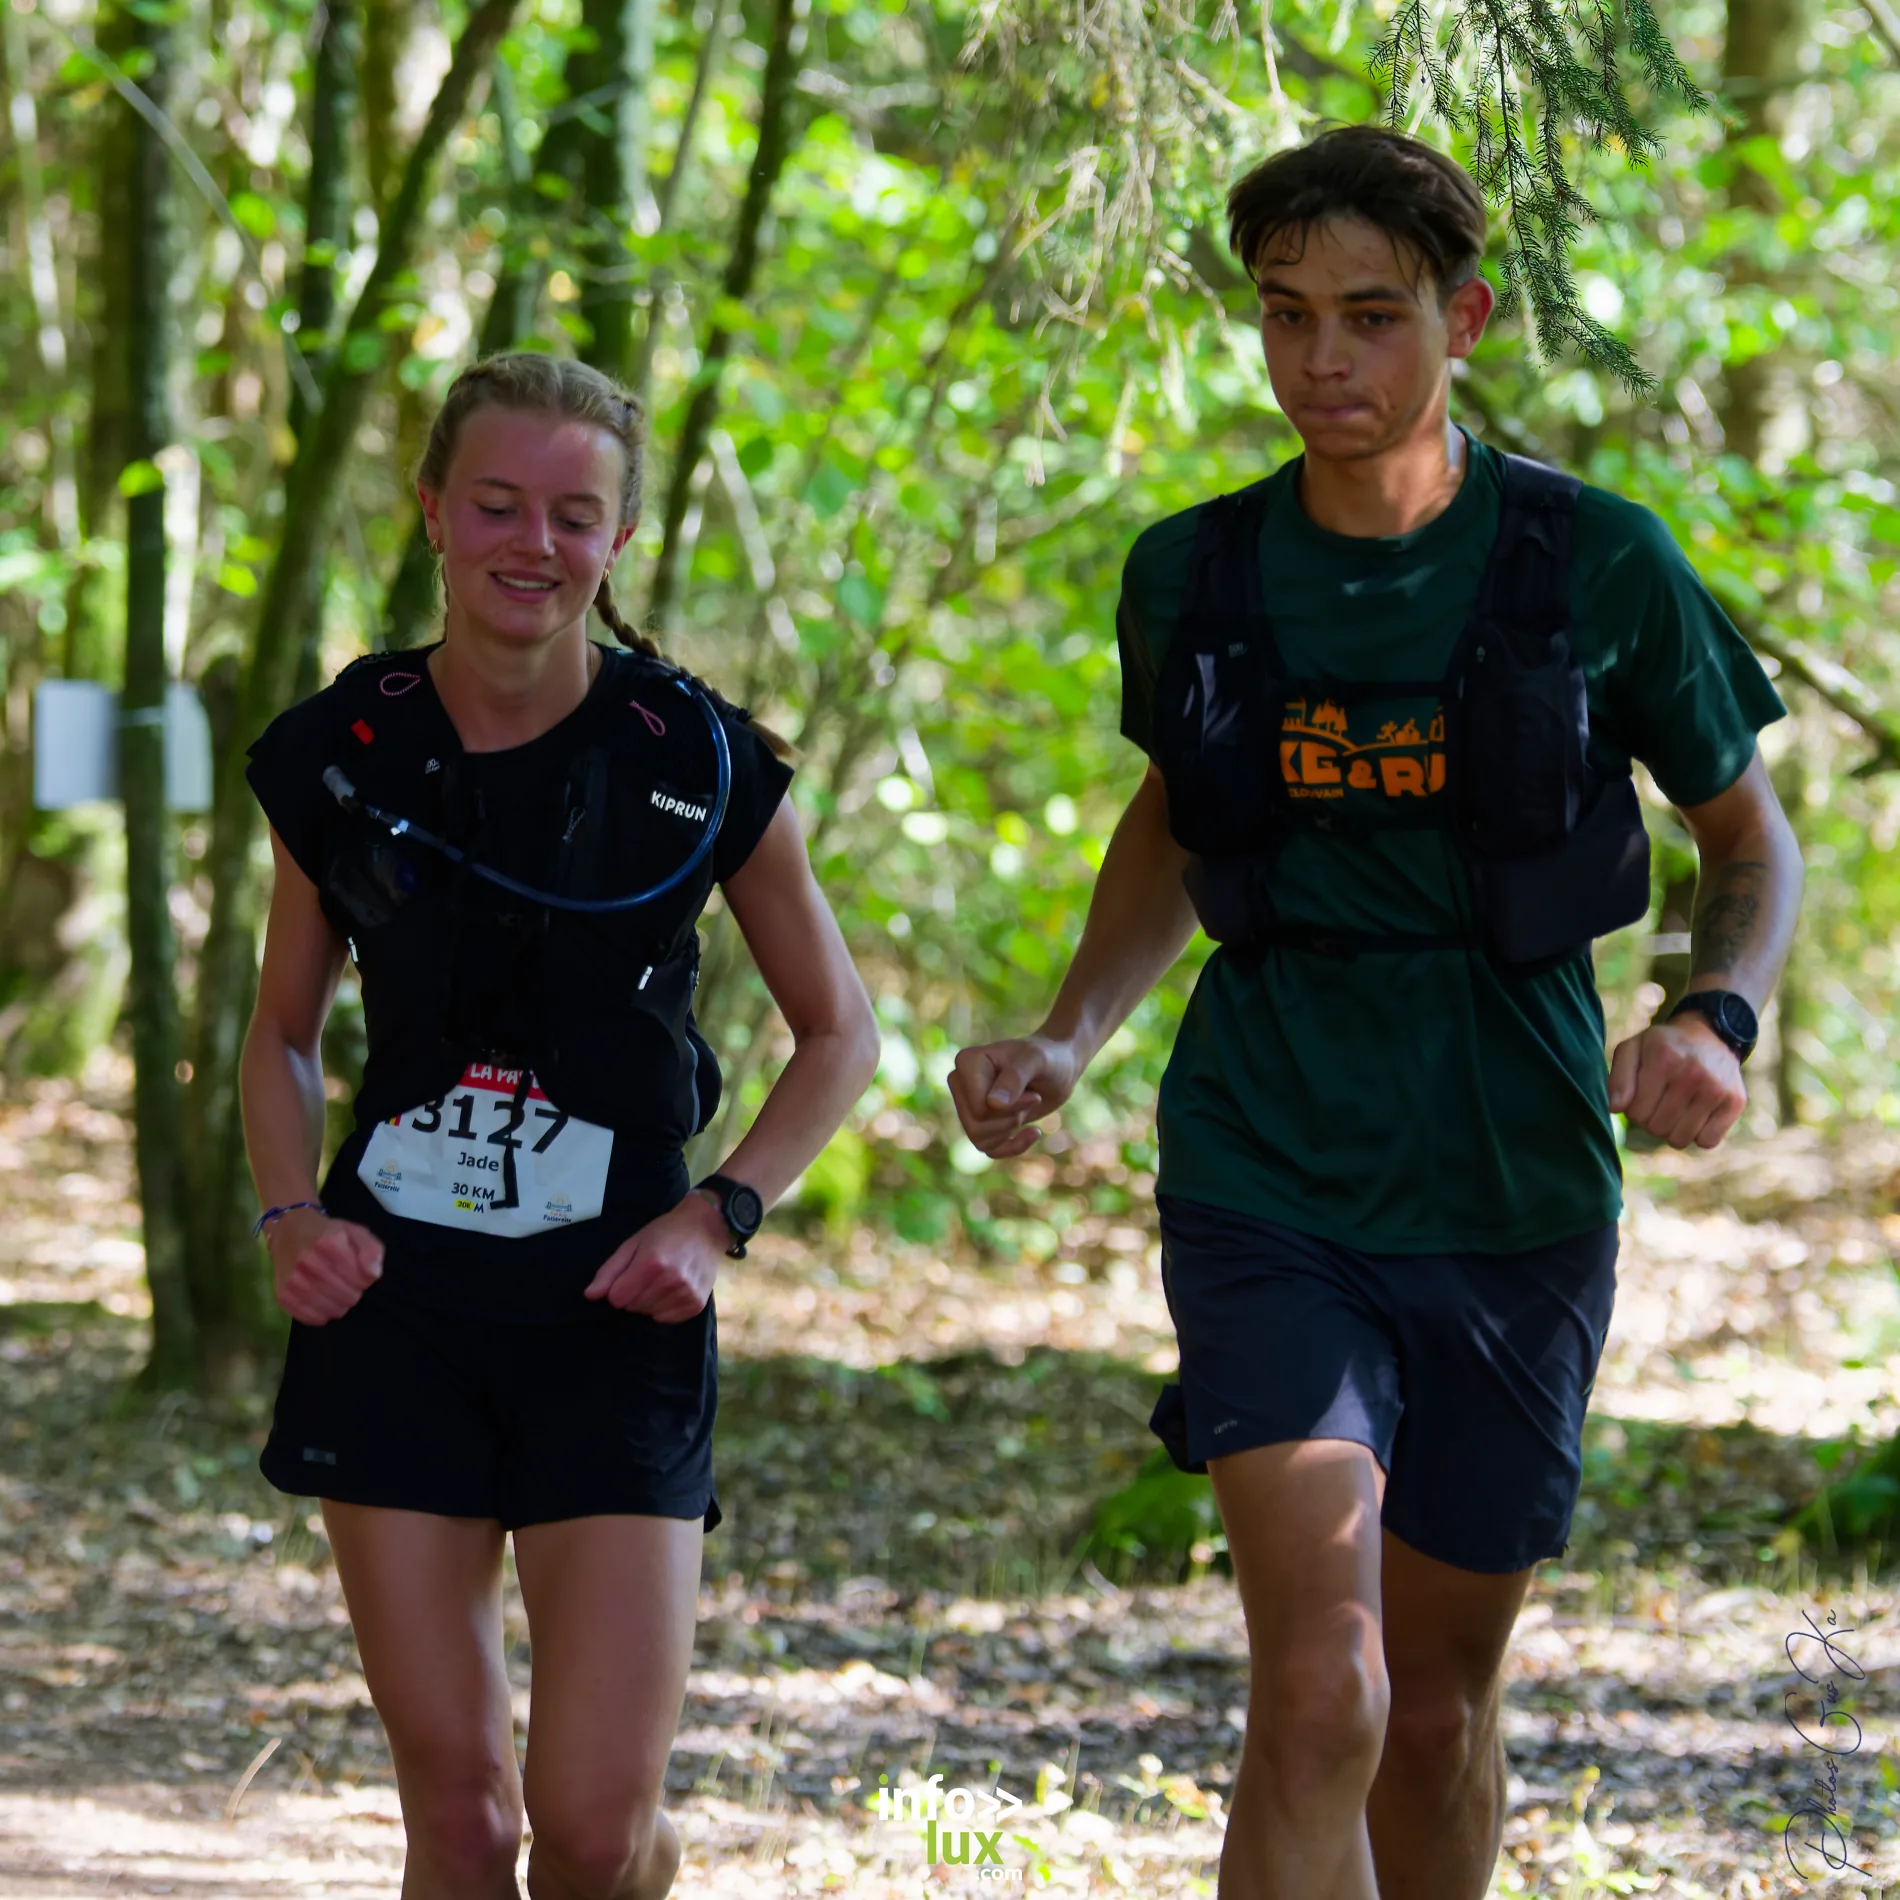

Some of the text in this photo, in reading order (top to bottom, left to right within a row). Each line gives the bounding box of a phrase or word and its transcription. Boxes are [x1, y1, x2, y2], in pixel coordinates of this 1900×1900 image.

[1347, 758, 1377, 789] &
[650, 790, 707, 822] KIPRUN
[470, 1062, 493, 1081] LA
[411, 1094, 570, 1154] 3127
[457, 1152, 500, 1172] Jade
[451, 1182, 496, 1201] 30 KM
